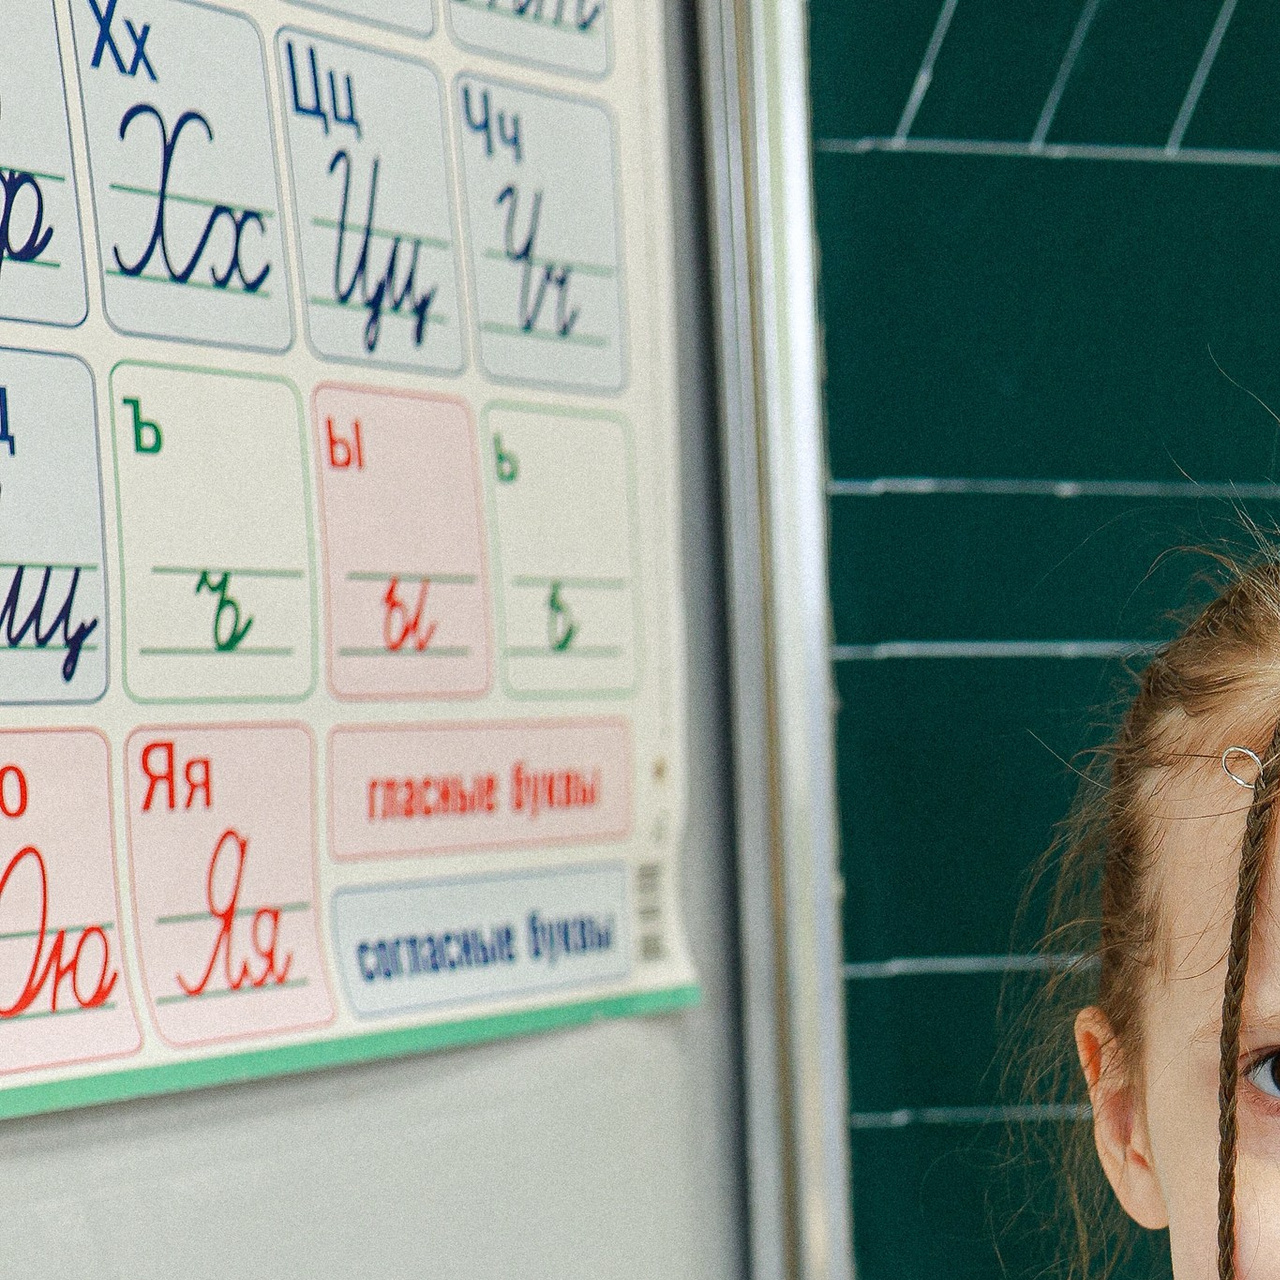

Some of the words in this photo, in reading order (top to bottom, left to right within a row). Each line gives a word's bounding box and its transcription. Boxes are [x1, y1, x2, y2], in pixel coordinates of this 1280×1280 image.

[286, 41, 363, 138] Цц
[461, 83, 524, 164] Чч
[113, 103, 270, 293] Хх
[140, 741, 213, 812] Яя
[368, 773, 495, 821] гласные
[511, 760, 601, 820] буквы
[177, 829, 293, 997] Яя
[358, 924, 516, 981] согласные
[526, 909, 614, 968] буквы
